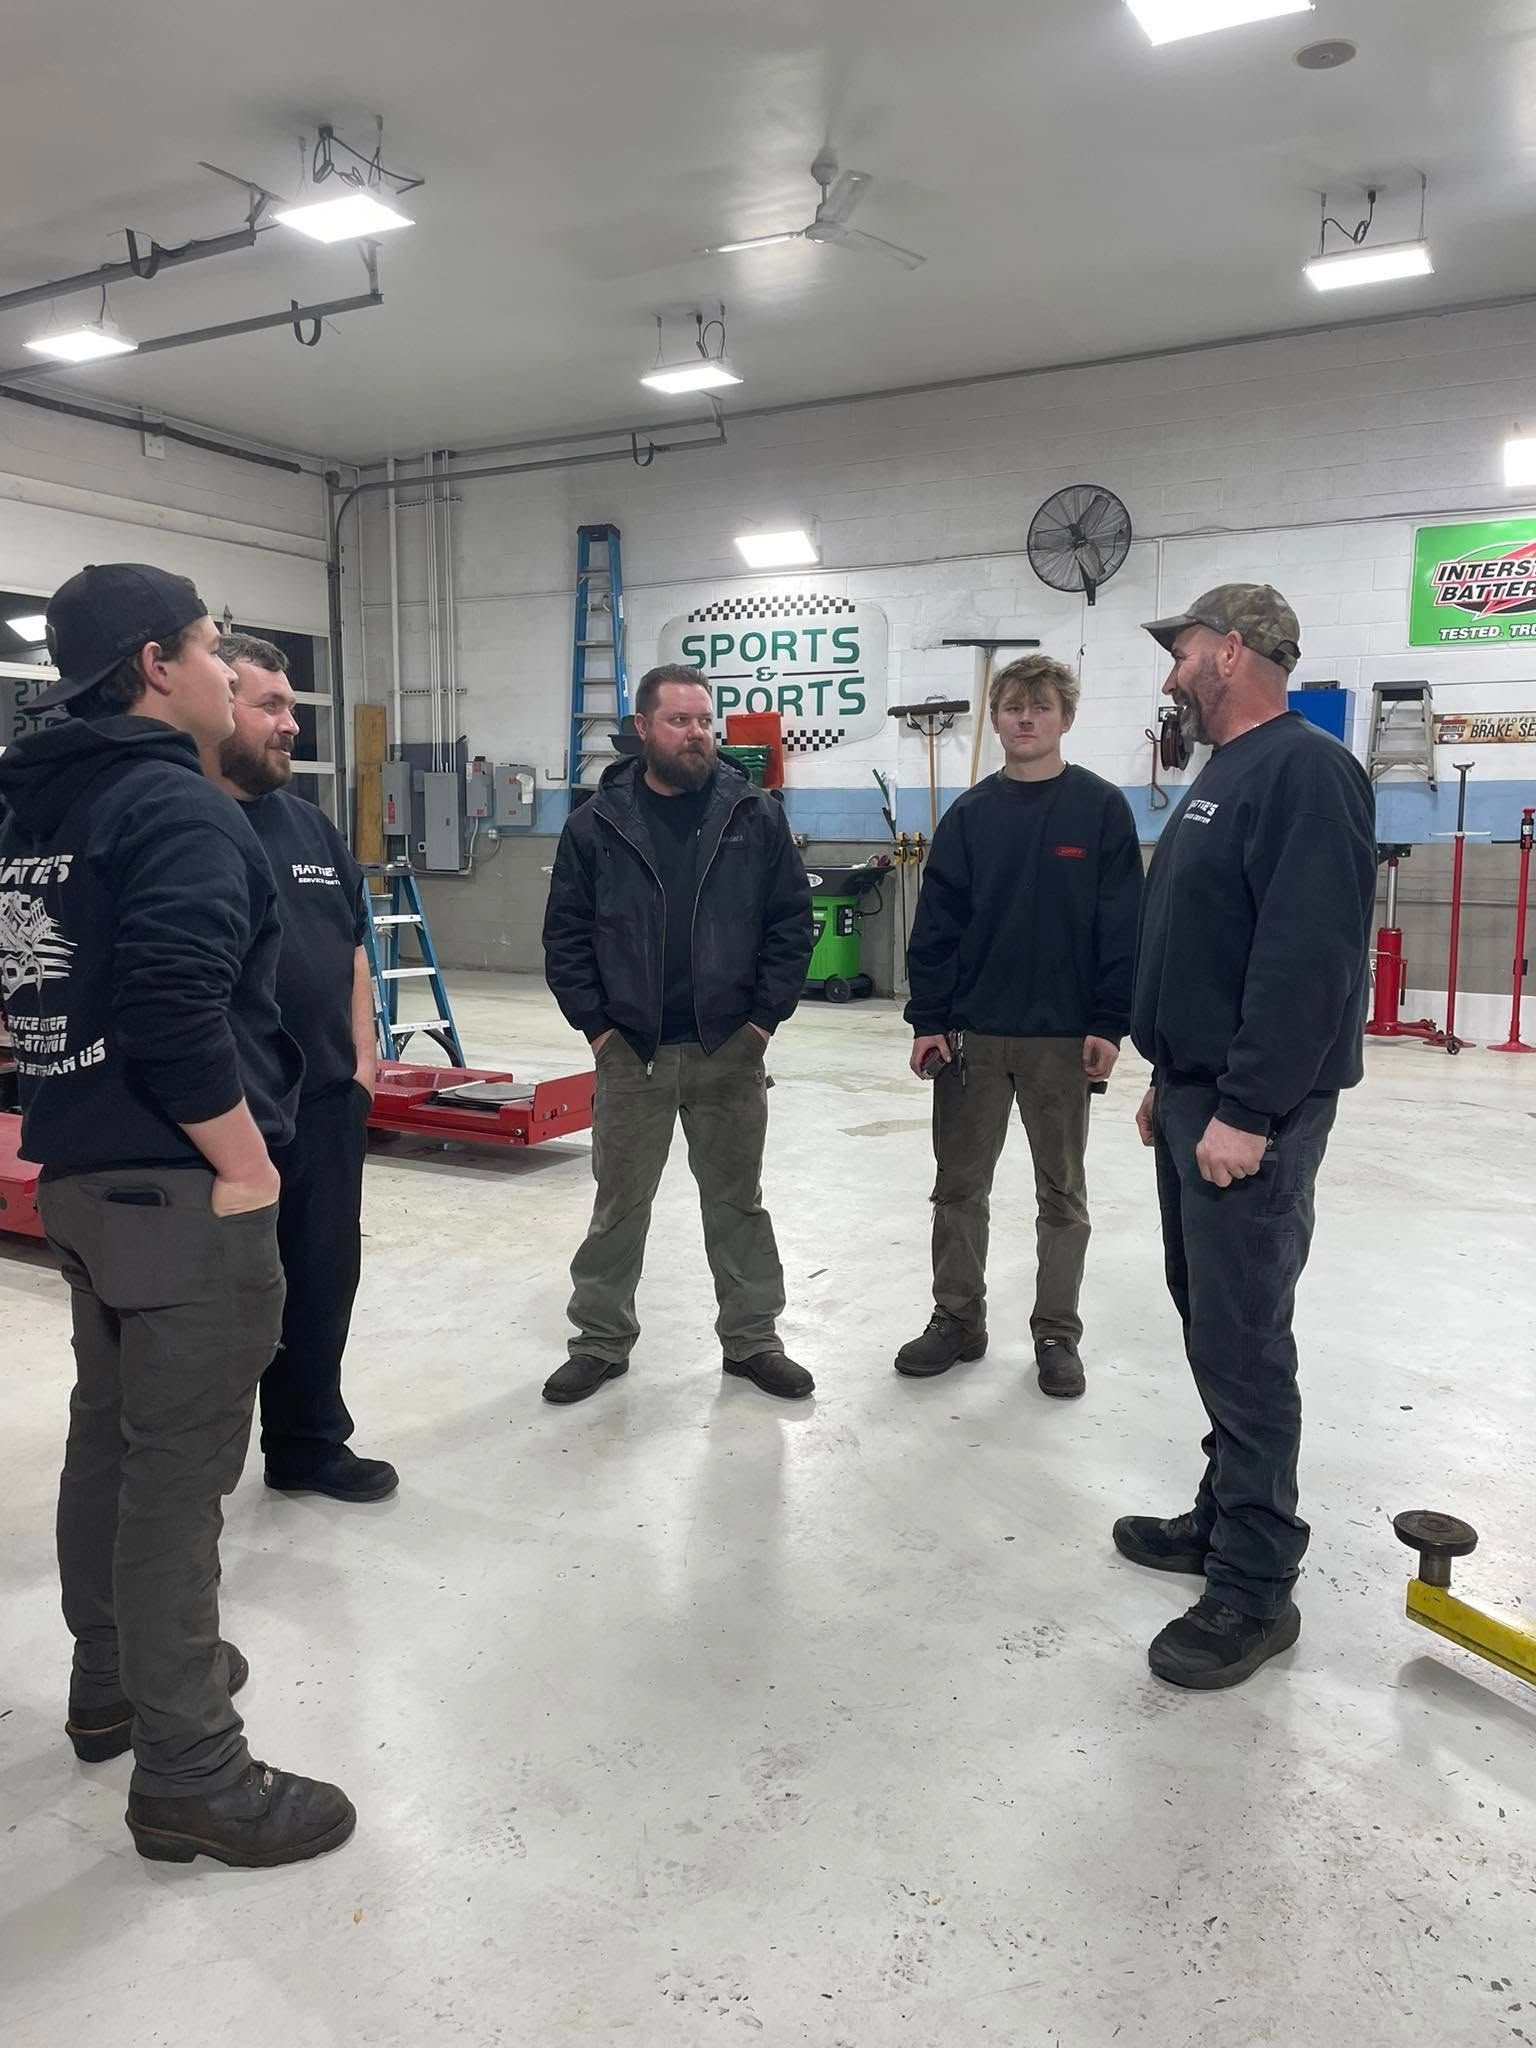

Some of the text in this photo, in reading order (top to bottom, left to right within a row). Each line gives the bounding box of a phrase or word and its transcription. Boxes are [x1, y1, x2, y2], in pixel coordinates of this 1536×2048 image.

[1438, 558, 1536, 582] INTERS
[1440, 625, 1503, 641] TESTED.
[681, 627, 861, 670] SPORTS
[755, 666, 778, 682] &
[711, 677, 866, 719] PORTS
[1470, 723, 1513, 738] BRAKE
[79, 1037, 106, 1068] US
